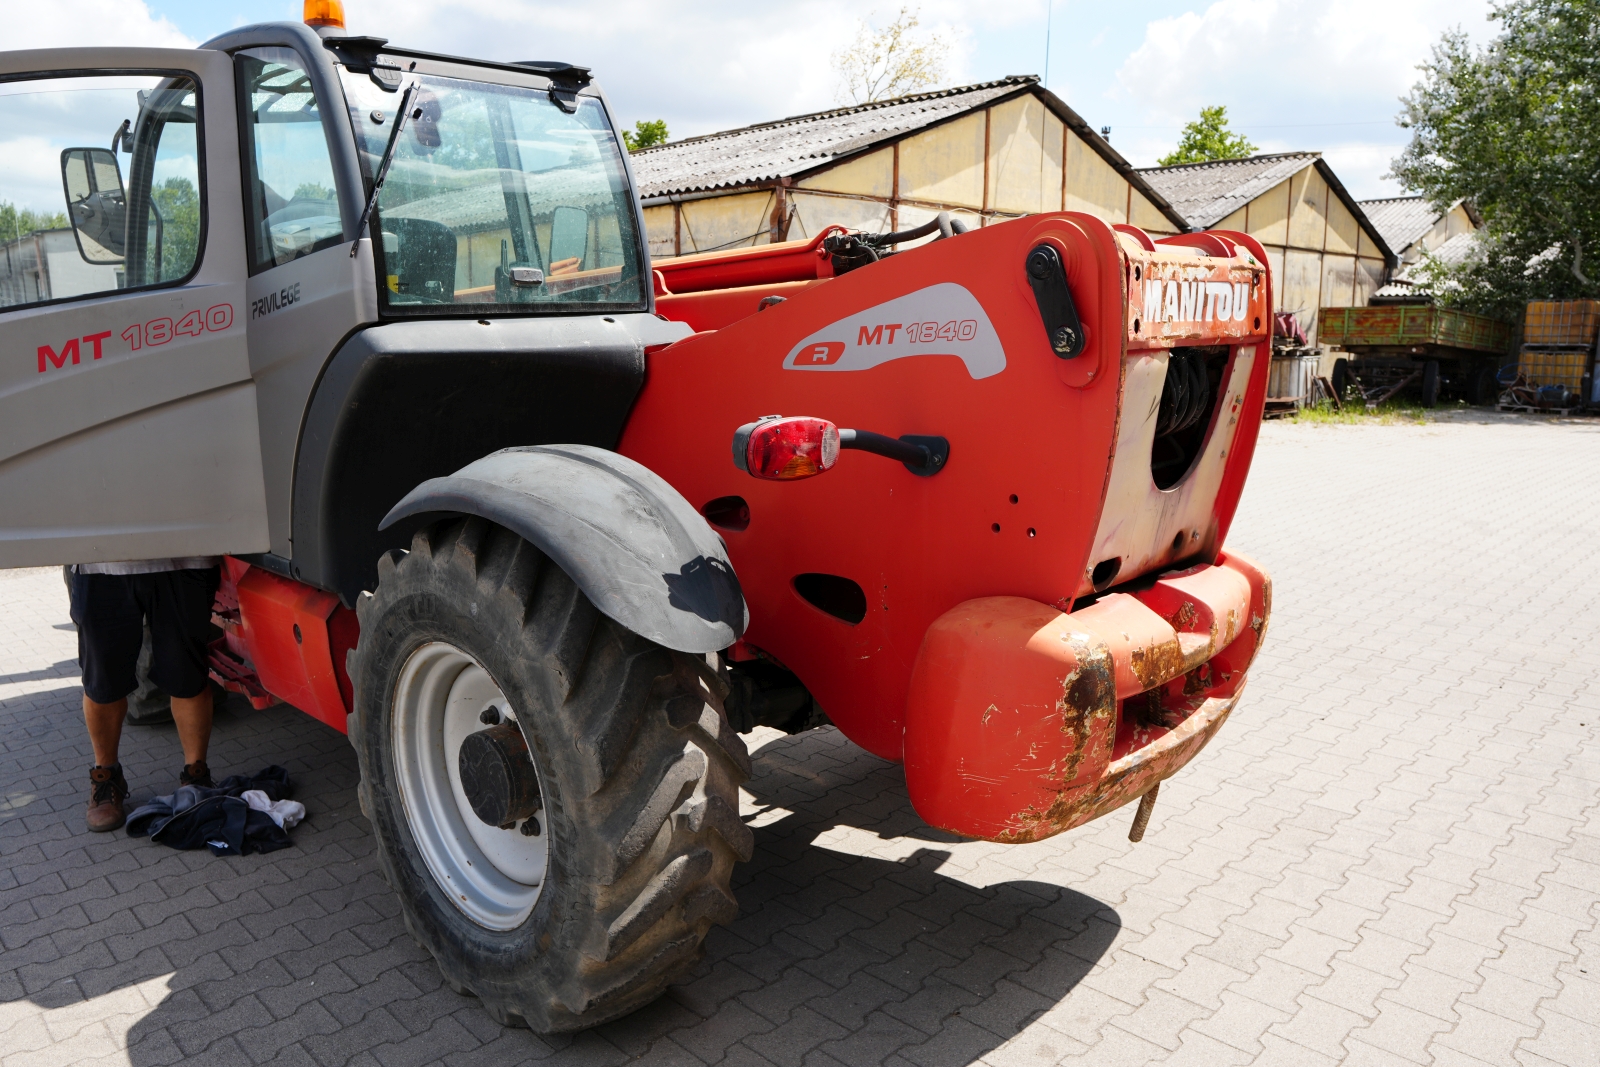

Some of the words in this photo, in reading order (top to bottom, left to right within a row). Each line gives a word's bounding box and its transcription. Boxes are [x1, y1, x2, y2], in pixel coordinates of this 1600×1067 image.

[251, 281, 301, 321] PRIVILEGE
[1143, 279, 1250, 323] MANITOU
[37, 330, 112, 373] MT
[120, 302, 234, 351] 1840
[857, 323, 902, 346] MT
[906, 319, 978, 344] 1840
[812, 346, 829, 362] R
